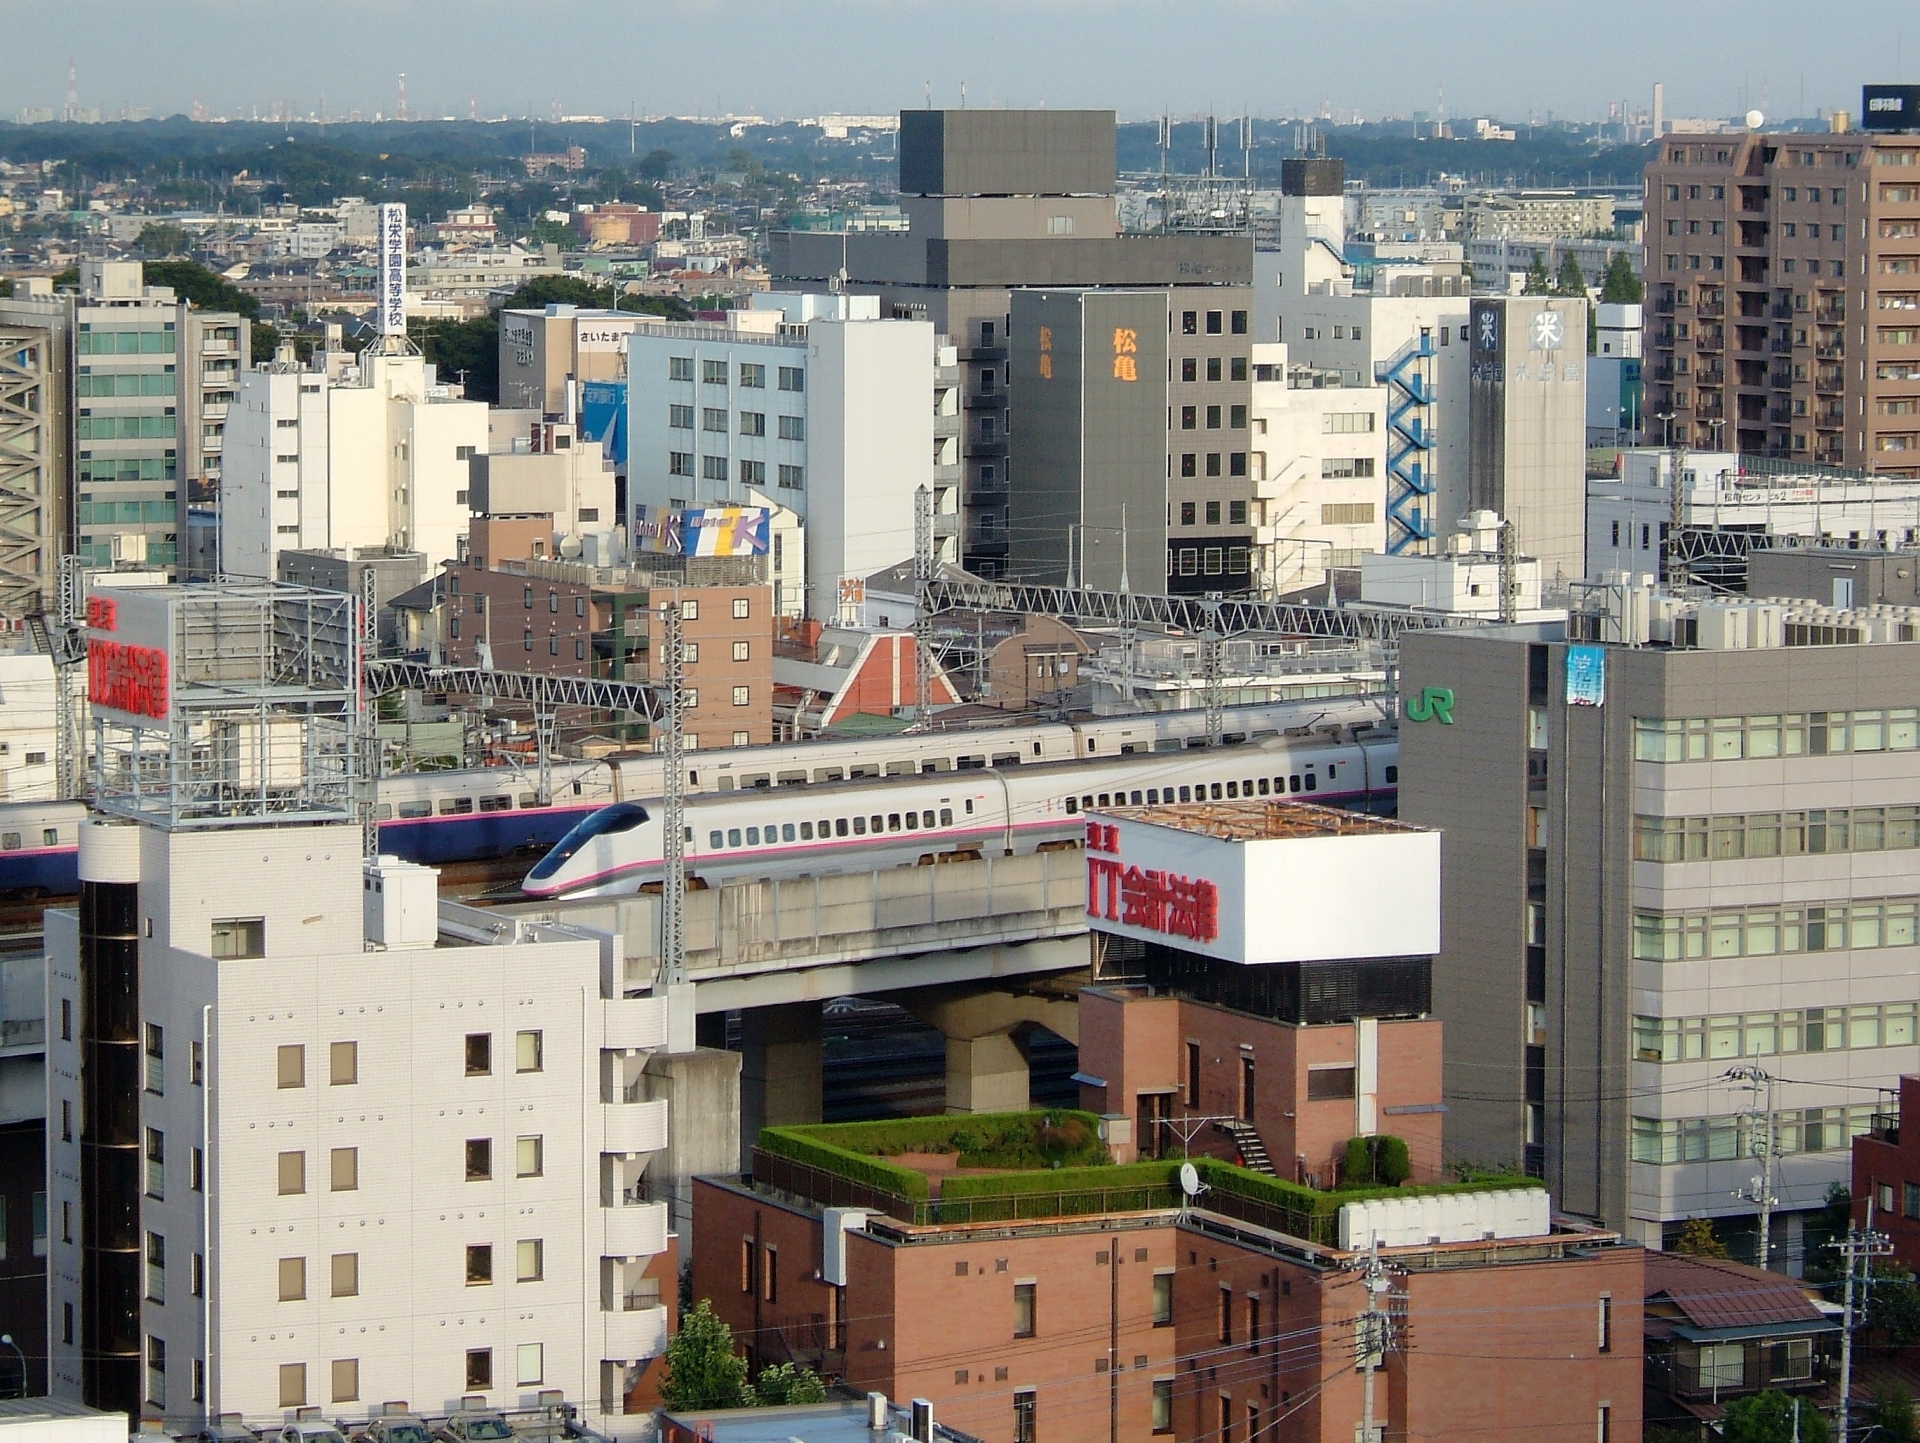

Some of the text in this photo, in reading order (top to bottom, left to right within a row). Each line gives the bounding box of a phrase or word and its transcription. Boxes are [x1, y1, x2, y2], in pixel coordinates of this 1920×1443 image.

[388, 208, 403, 327] 松栄学園高等学校
[1113, 328, 1137, 381] 松亀
[664, 515, 682, 552] K
[731, 514, 765, 551] K
[1407, 687, 1454, 724] JR
